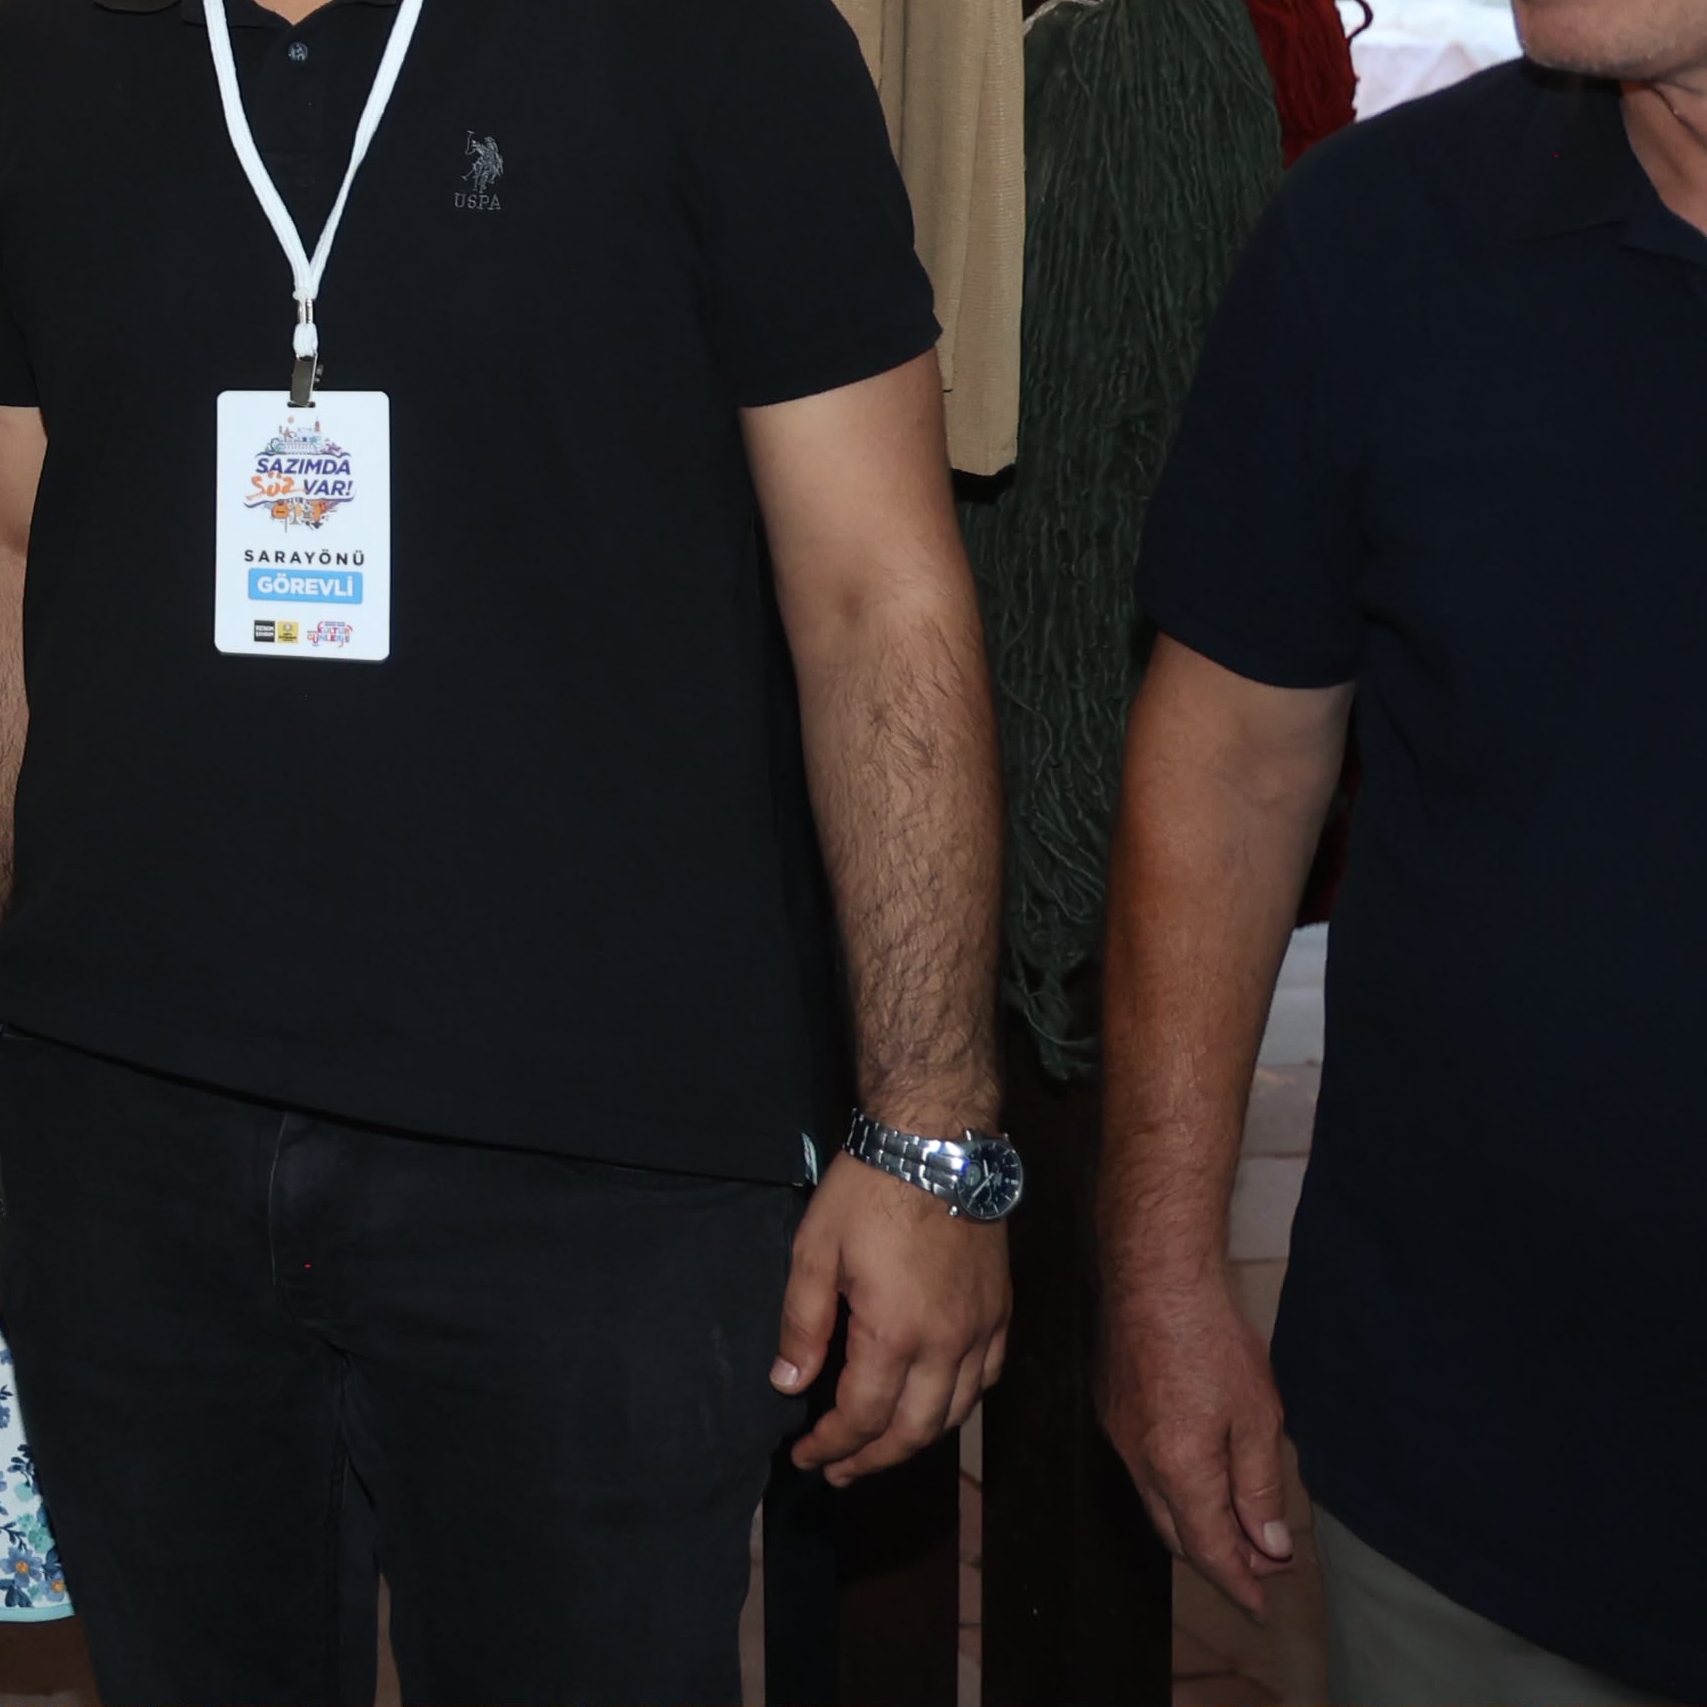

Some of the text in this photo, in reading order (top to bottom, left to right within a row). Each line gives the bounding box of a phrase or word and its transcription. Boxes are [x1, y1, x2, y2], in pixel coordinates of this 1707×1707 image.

[454, 192, 501, 210] USPA
[256, 458, 351, 475] SAZIMDA
[304, 480, 352, 496] VAR!
[244, 549, 365, 566] SARAYÖNÜ
[257, 573, 354, 597] GÖREVLİ
